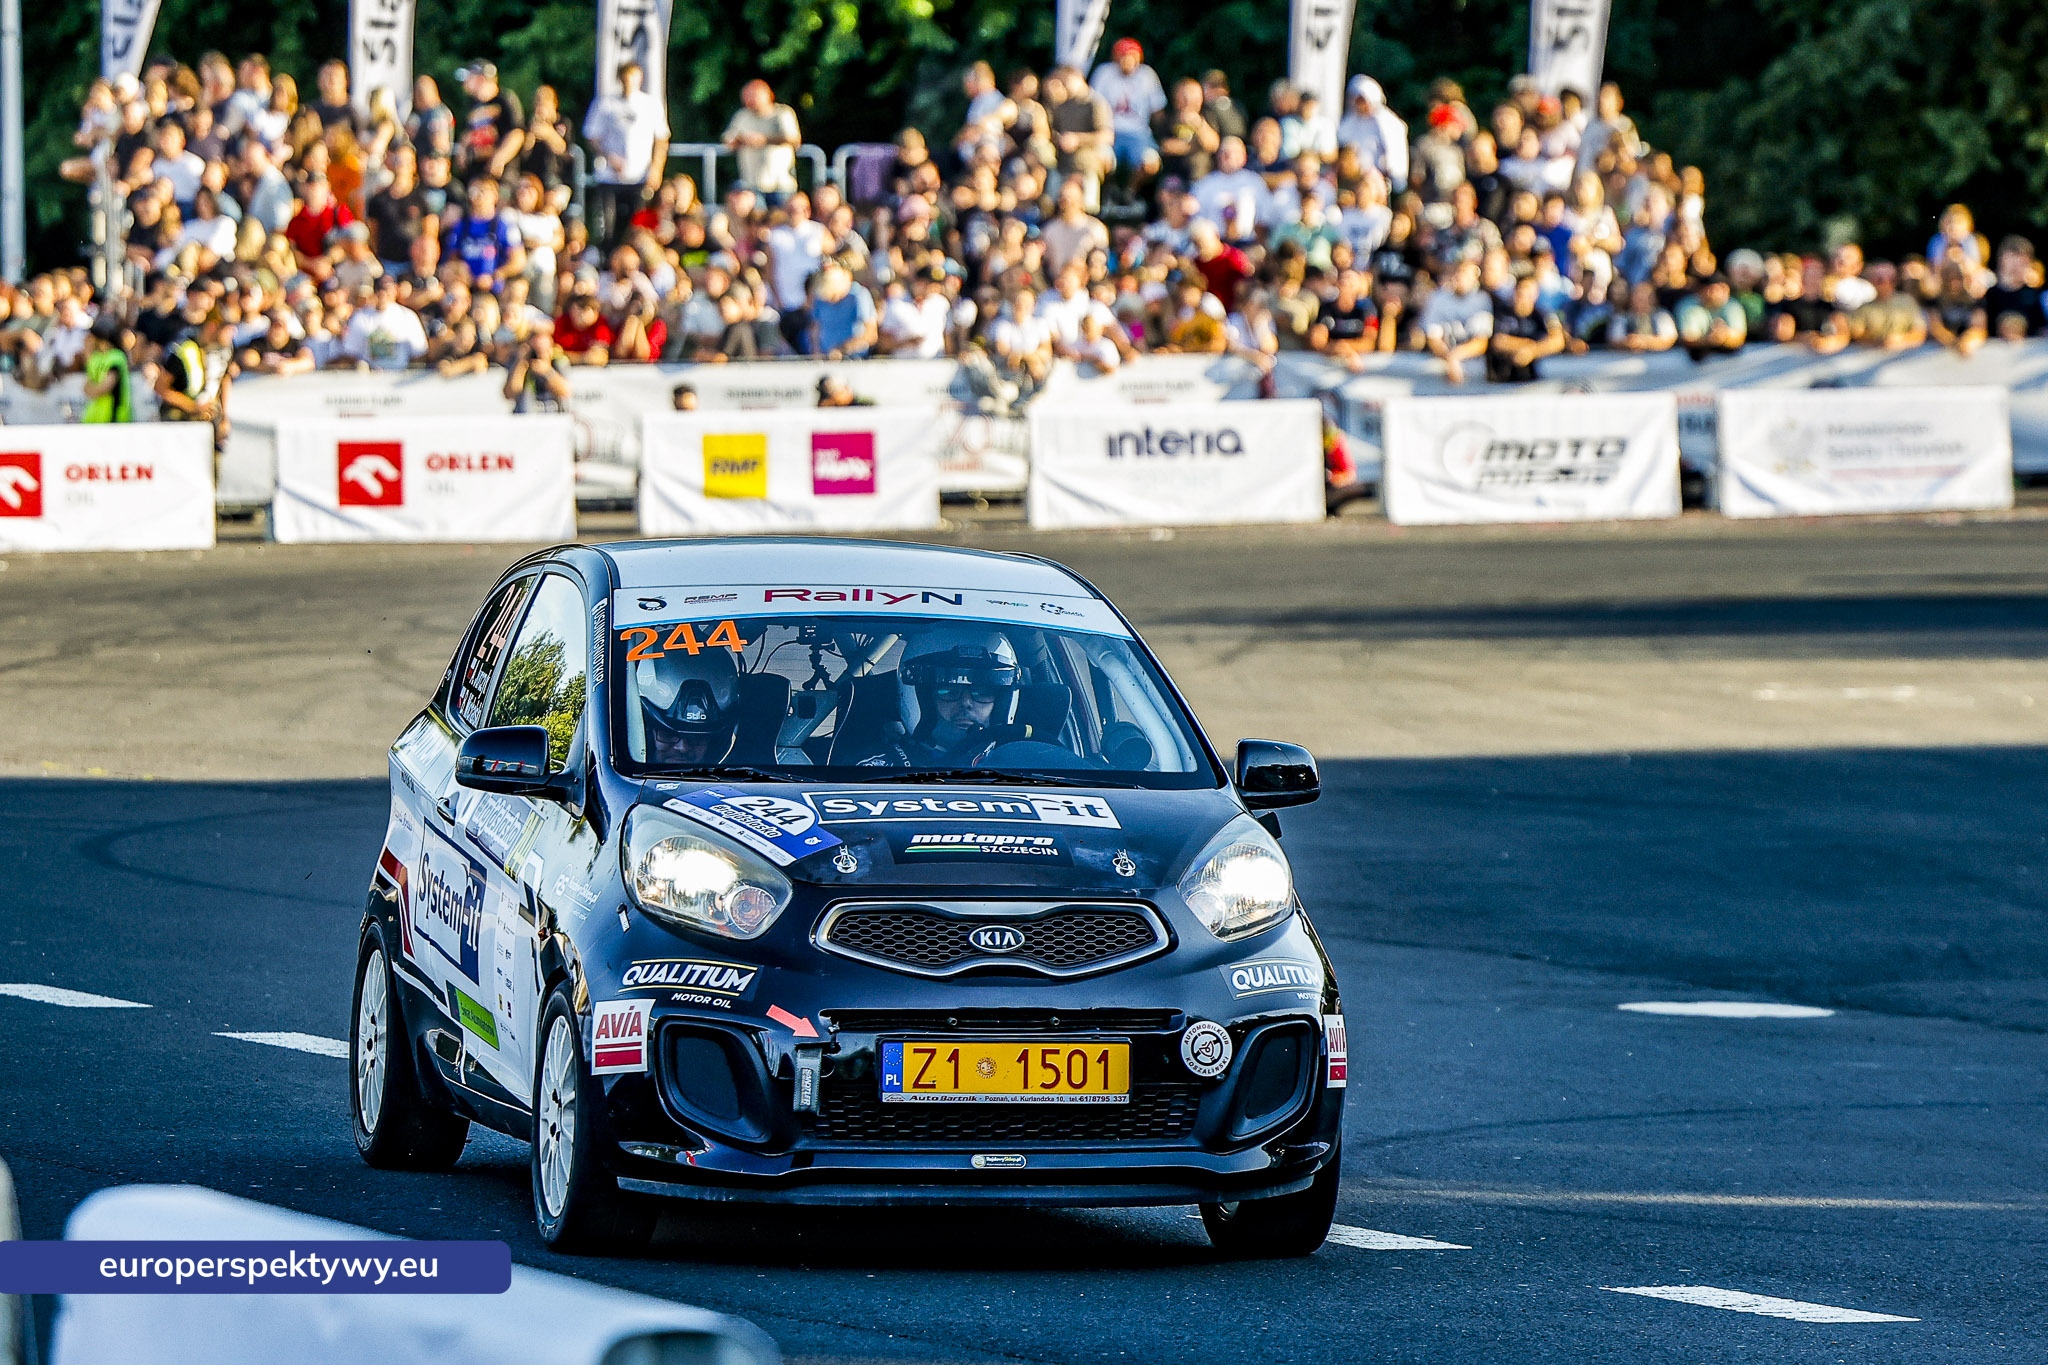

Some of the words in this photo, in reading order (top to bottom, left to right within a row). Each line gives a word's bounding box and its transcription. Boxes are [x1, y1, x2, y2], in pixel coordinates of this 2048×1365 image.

[1106, 424, 1244, 460] interia
[64, 462, 154, 482] ORLEN
[425, 452, 514, 473] ORLEN
[619, 620, 749, 662] 244
[738, 798, 809, 827] 244
[911, 832, 1055, 846] motopro
[980, 845, 1059, 857] SZCZECIN
[978, 931, 1017, 946] KIA
[622, 963, 756, 992] QUALITIUM
[1231, 965, 1322, 991] QUALITIUM
[671, 992, 711, 1005] MOTOR
[712, 998, 732, 1009] OIL
[595, 1005, 643, 1040] AVIA
[885, 1074, 901, 1086] PL
[912, 1048, 960, 1089] Z1
[1016, 1048, 1110, 1090] 1501
